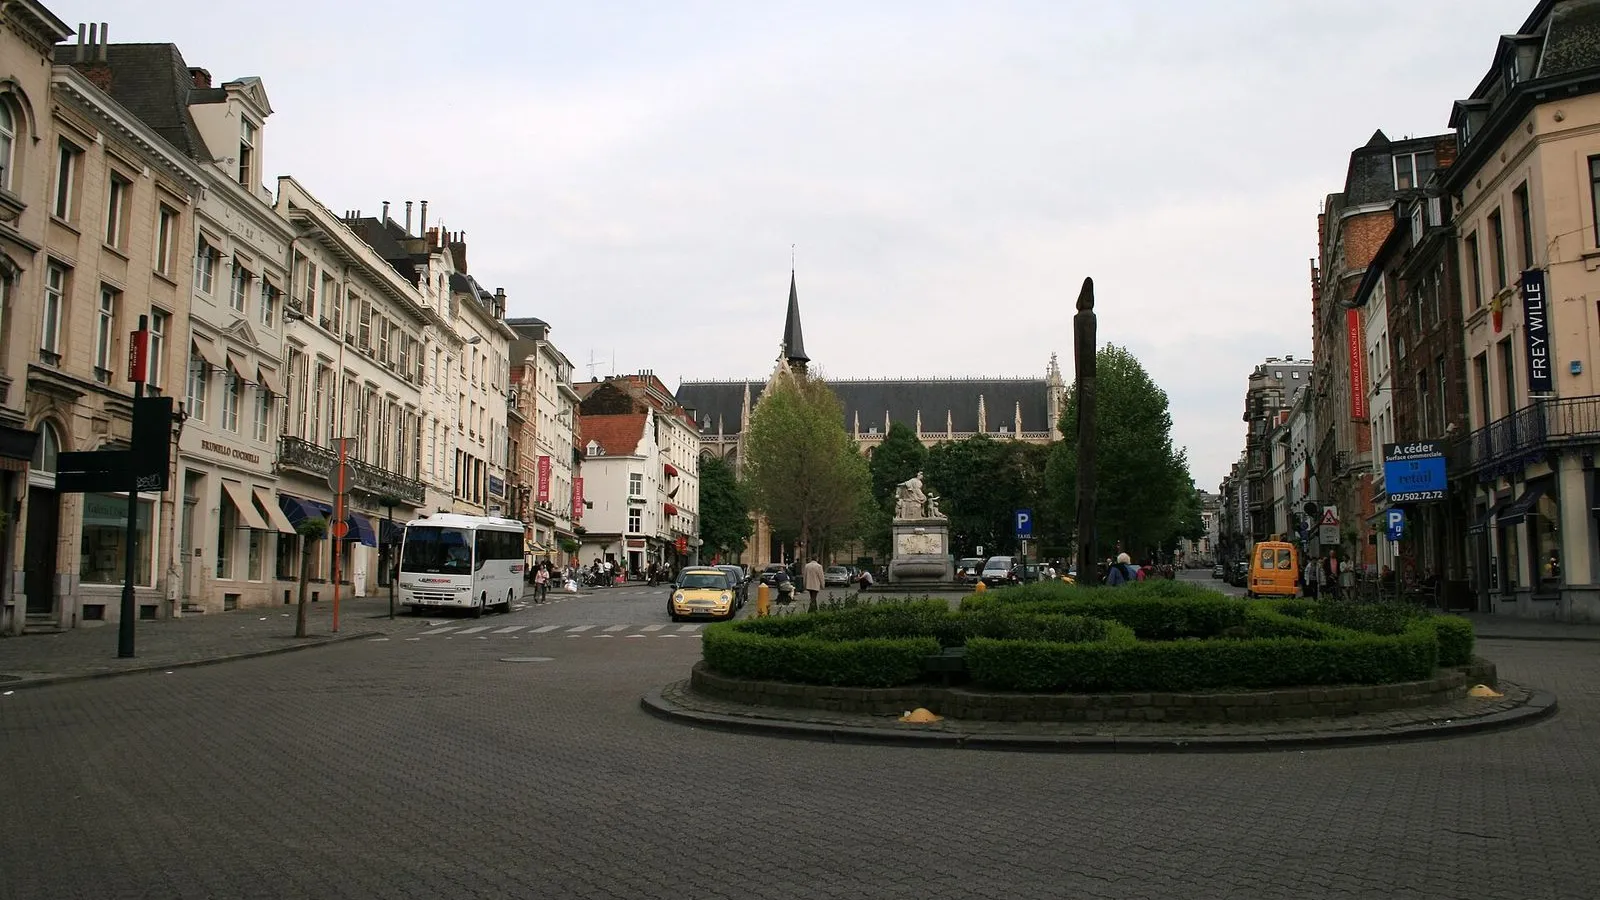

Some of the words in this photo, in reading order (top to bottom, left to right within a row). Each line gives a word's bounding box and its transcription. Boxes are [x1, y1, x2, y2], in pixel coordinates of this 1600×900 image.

[1526, 283, 1543, 331] WILLE
[1530, 336, 1547, 379] FREY
[201, 440, 231, 457] BRUNELLO
[1385, 454, 1406, 462] Surface
[1406, 451, 1442, 460] commerciale
[1393, 445, 1402, 455] A
[1404, 442, 1434, 454] céder
[1391, 491, 1443, 502] 02/502.72.72
[1017, 513, 1029, 529] P
[1389, 512, 1402, 529] P
